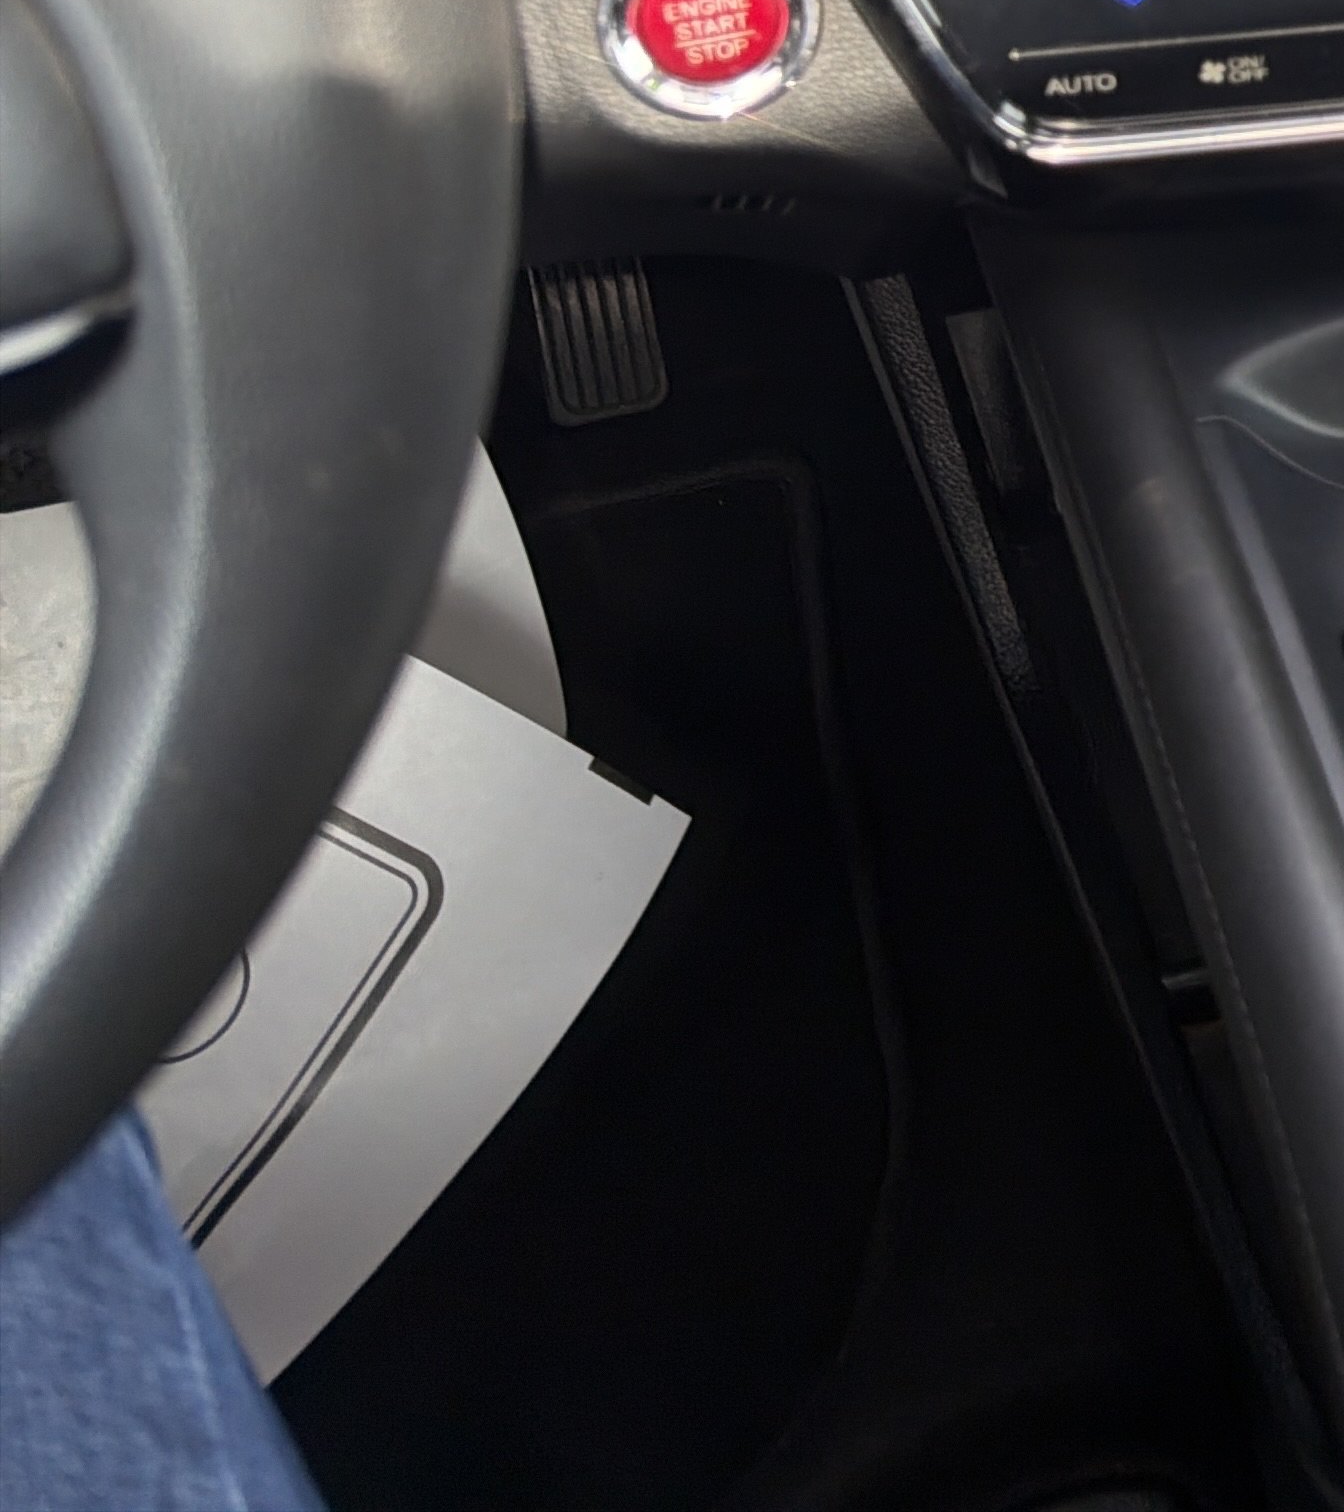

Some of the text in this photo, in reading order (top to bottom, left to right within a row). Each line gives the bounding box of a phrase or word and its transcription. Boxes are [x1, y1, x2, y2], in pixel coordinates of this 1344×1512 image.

[675, 12, 750, 42] START
[685, 38, 750, 66] STOP
[1044, 72, 1118, 97] AUTO
